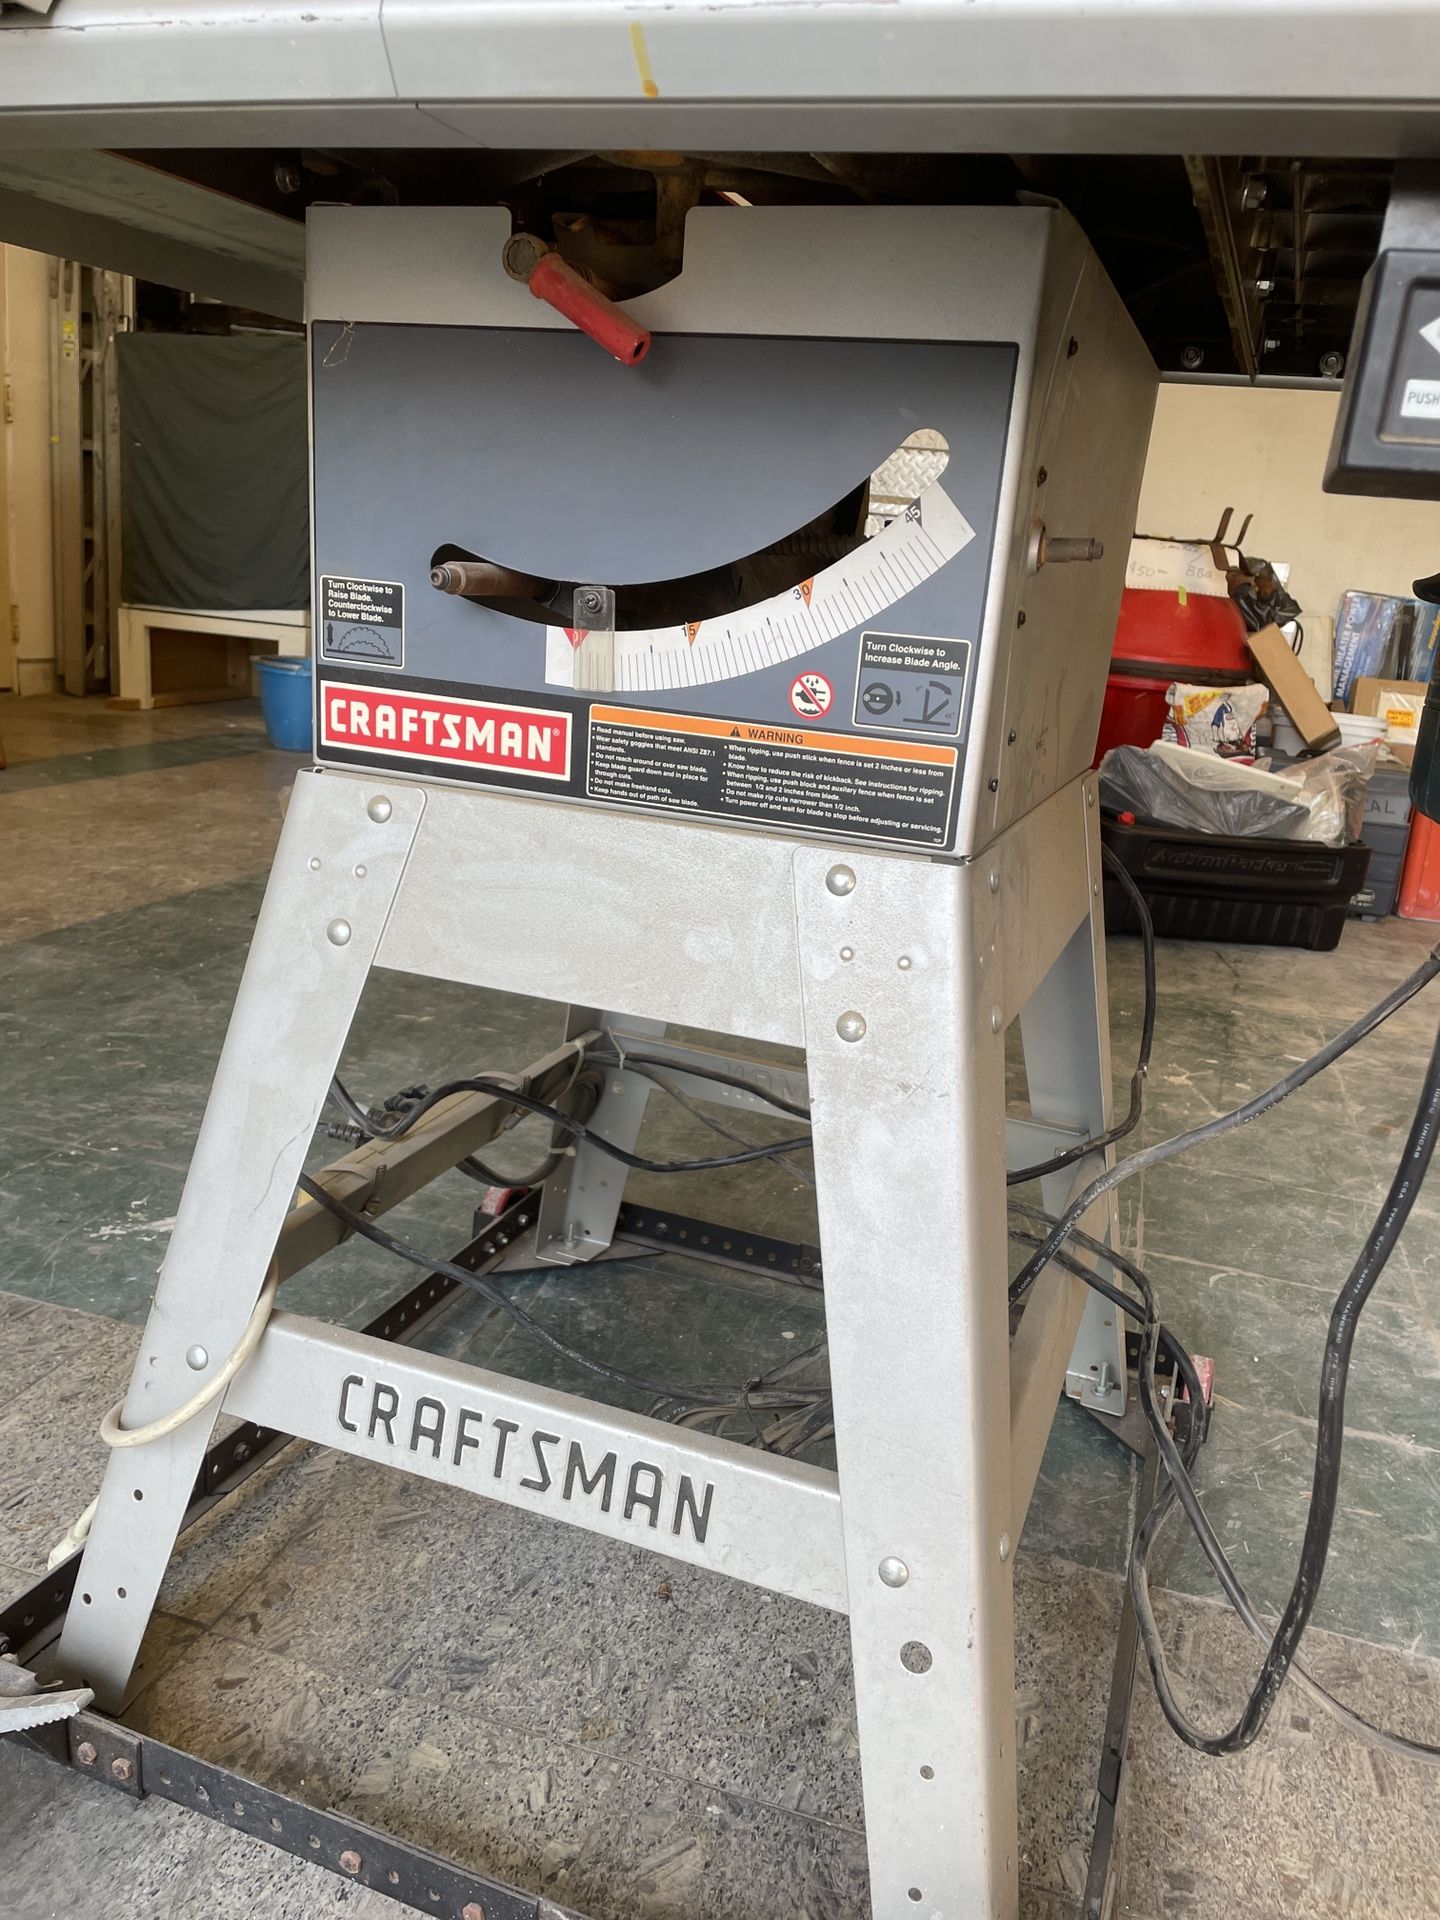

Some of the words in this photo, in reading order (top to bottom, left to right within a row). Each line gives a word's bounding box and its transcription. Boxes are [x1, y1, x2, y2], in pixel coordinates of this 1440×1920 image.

[1407, 391, 1440, 406] PUSH
[905, 505, 921, 524] 45
[328, 580, 345, 589] Turn
[346, 582, 384, 594] Clockwise
[385, 586, 393, 594] to
[793, 584, 810, 600] 30
[328, 589, 348, 599] Raise
[350, 592, 373, 602] Blade.
[328, 599, 393, 614] Counterclockwise
[328, 609, 336, 617] to
[337, 610, 360, 620] Lower
[361, 612, 384, 622] Blade.
[681, 624, 697, 637] 15
[866, 641, 886, 651] Turn
[889, 643, 935, 656] Clockwise
[936, 648, 946, 657] to
[865, 653, 902, 664] Increase
[904, 657, 930, 667] Blade
[932, 660, 961, 671] Angle.
[1336, 632, 1360, 698] MANAGEMENT
[597, 726, 611, 734] Read
[613, 729, 634, 737] manual
[635, 731, 654, 739] before
[655, 735, 671, 743] using
[748, 728, 803, 744] WARNING
[596, 744, 626, 753] standards.
[612, 738, 629, 746] safety
[630, 740, 654, 748] goggles
[728, 753, 747, 761] blade.
[729, 744, 746, 753] When
[747, 747, 771, 757] ripping,
[785, 752, 801, 760] push
[818, 756, 836, 764] when
[837, 758, 855, 766] fence
[881, 763, 902, 772] inches
[912, 767, 926, 775] less
[928, 769, 944, 777] from
[595, 760, 610, 769] Keep
[646, 768, 662, 776] down
[682, 773, 699, 781] place
[633, 758, 654, 766] around
[690, 765, 708, 773] blade.
[595, 769, 617, 779] through
[728, 762, 745, 770] Know
[768, 768, 790, 776] reduce
[824, 775, 853, 785] kickback.
[854, 778, 867, 786] See
[868, 780, 907, 791] instructions
[919, 786, 945, 797] ripping.
[631, 783, 657, 792] freehand
[658, 787, 672, 795] cuts.
[726, 780, 752, 789] between
[783, 787, 804, 796] inches
[806, 790, 820, 798] from
[821, 792, 841, 801] blade.
[727, 770, 744, 779] When
[745, 773, 769, 783] ripping,
[783, 779, 799, 787] push
[858, 788, 876, 796] fence
[877, 791, 895, 799] when
[896, 793, 915, 801] fence
[594, 786, 609, 795] Keep
[610, 788, 628, 796] hands
[681, 798, 699, 807] blade.
[765, 794, 774, 802] rip
[789, 798, 818, 807] narrower
[818, 801, 833, 809] than
[845, 804, 860, 813] inch.
[1364, 799, 1396, 815] AL
[806, 808, 824, 817] blade
[833, 812, 847, 821] stop
[848, 814, 869, 823] before
[870, 817, 900, 828] adjusting
[910, 823, 942, 834] servicing.
[1384, 1207, 1398, 1229] TYPE
[338, 1374, 714, 1544] CRAFTSMAN
